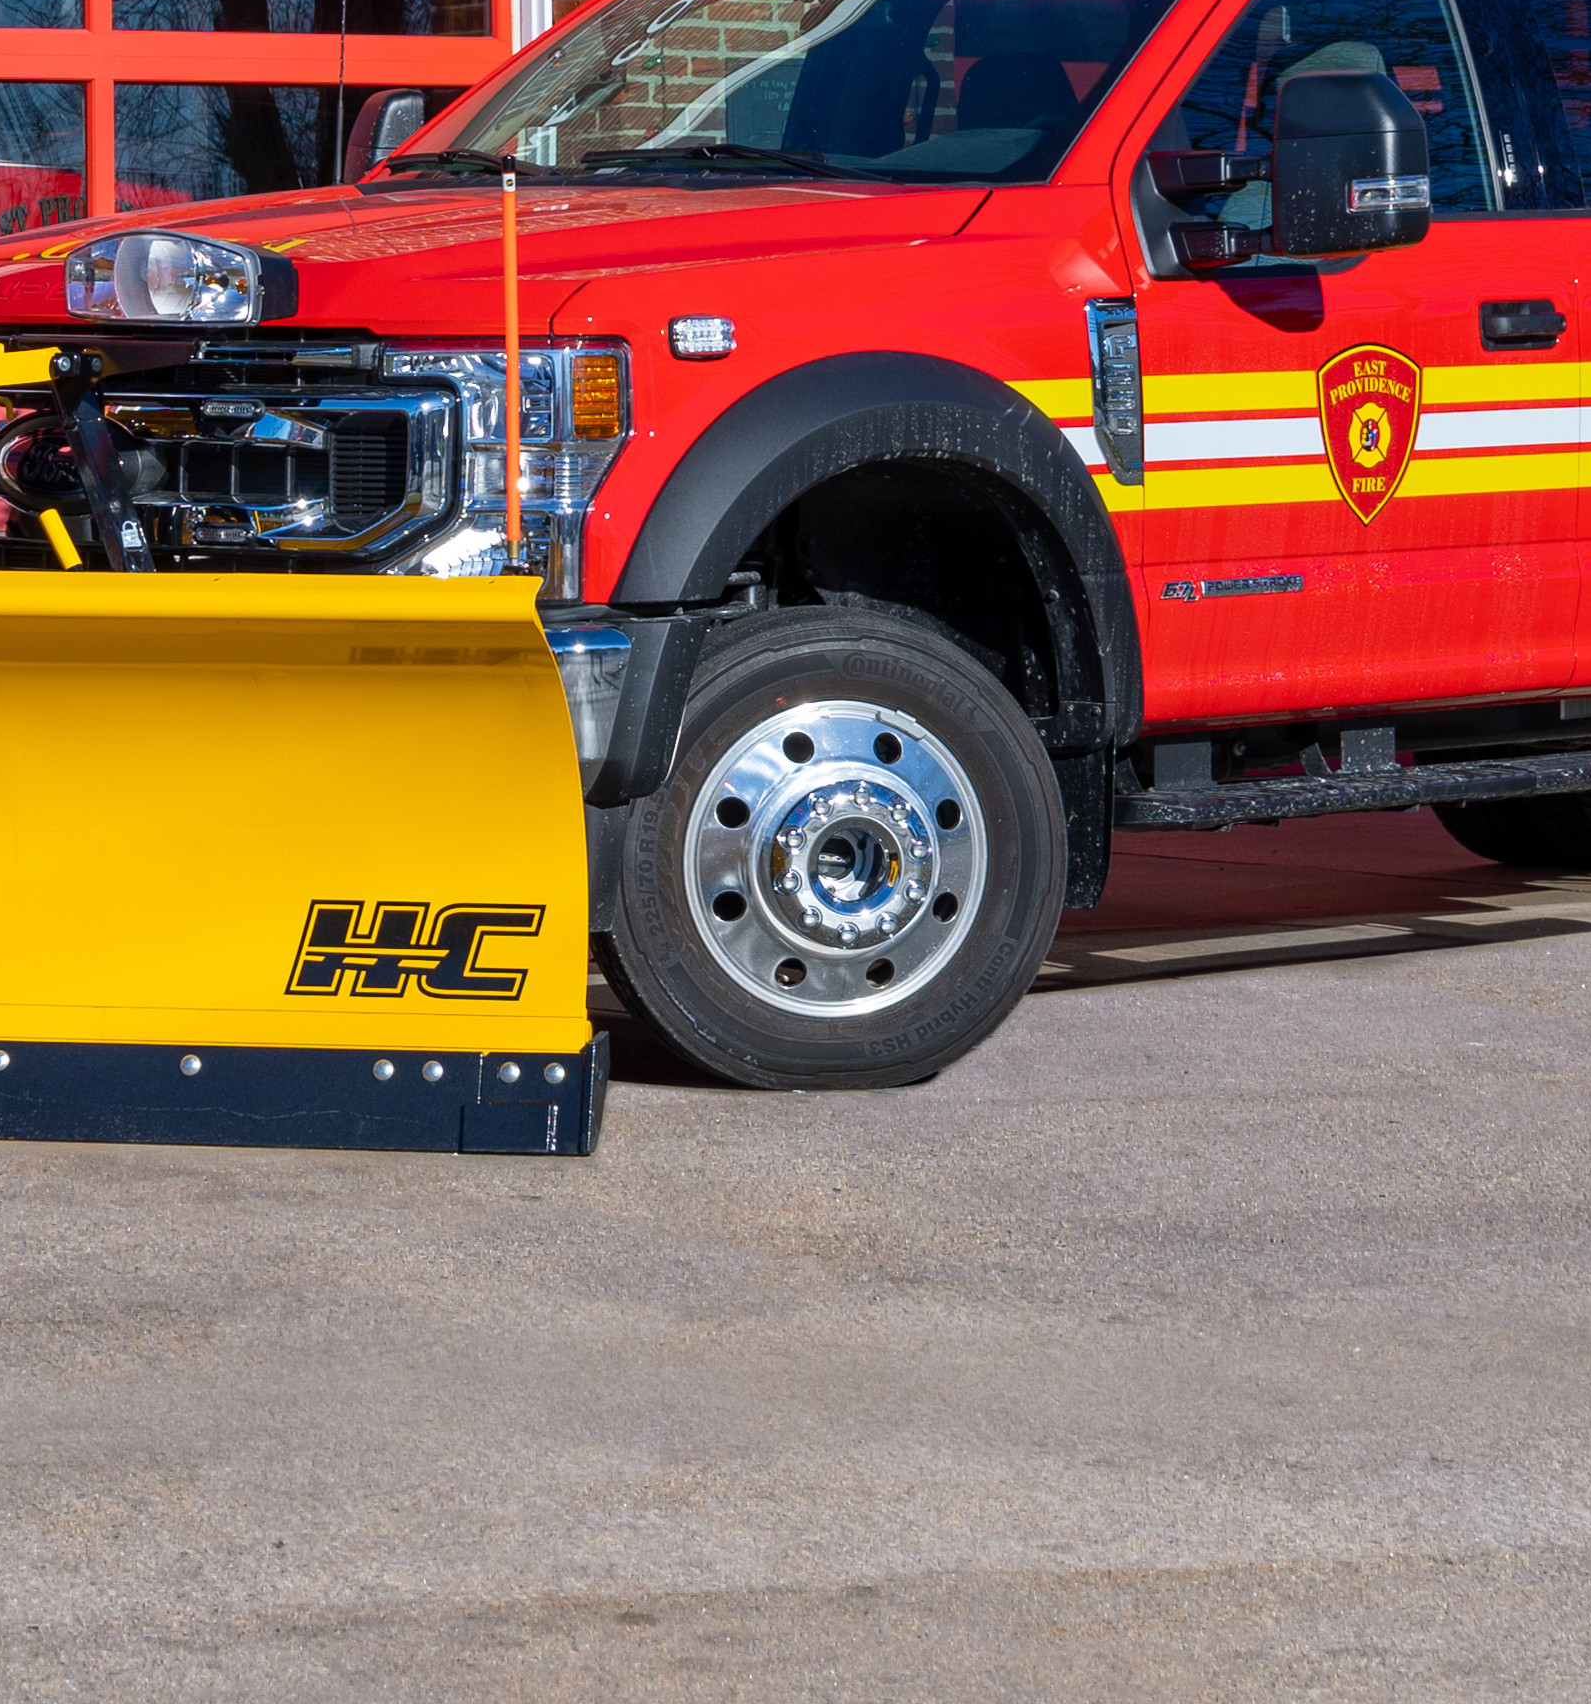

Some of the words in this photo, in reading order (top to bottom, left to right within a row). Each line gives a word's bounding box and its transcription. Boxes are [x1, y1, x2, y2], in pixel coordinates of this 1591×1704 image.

[1352, 360, 1387, 378] EAST
[1328, 377, 1412, 405] PROVIDENCE
[1352, 476, 1386, 494] FIRE
[1207, 579, 1250, 593] POWER
[1252, 575, 1303, 590] STROKE
[284, 899, 547, 1001] HC
[974, 941, 1016, 994] Conti
[913, 991, 979, 1042] Hybrid
[868, 1032, 915, 1057] HS3
